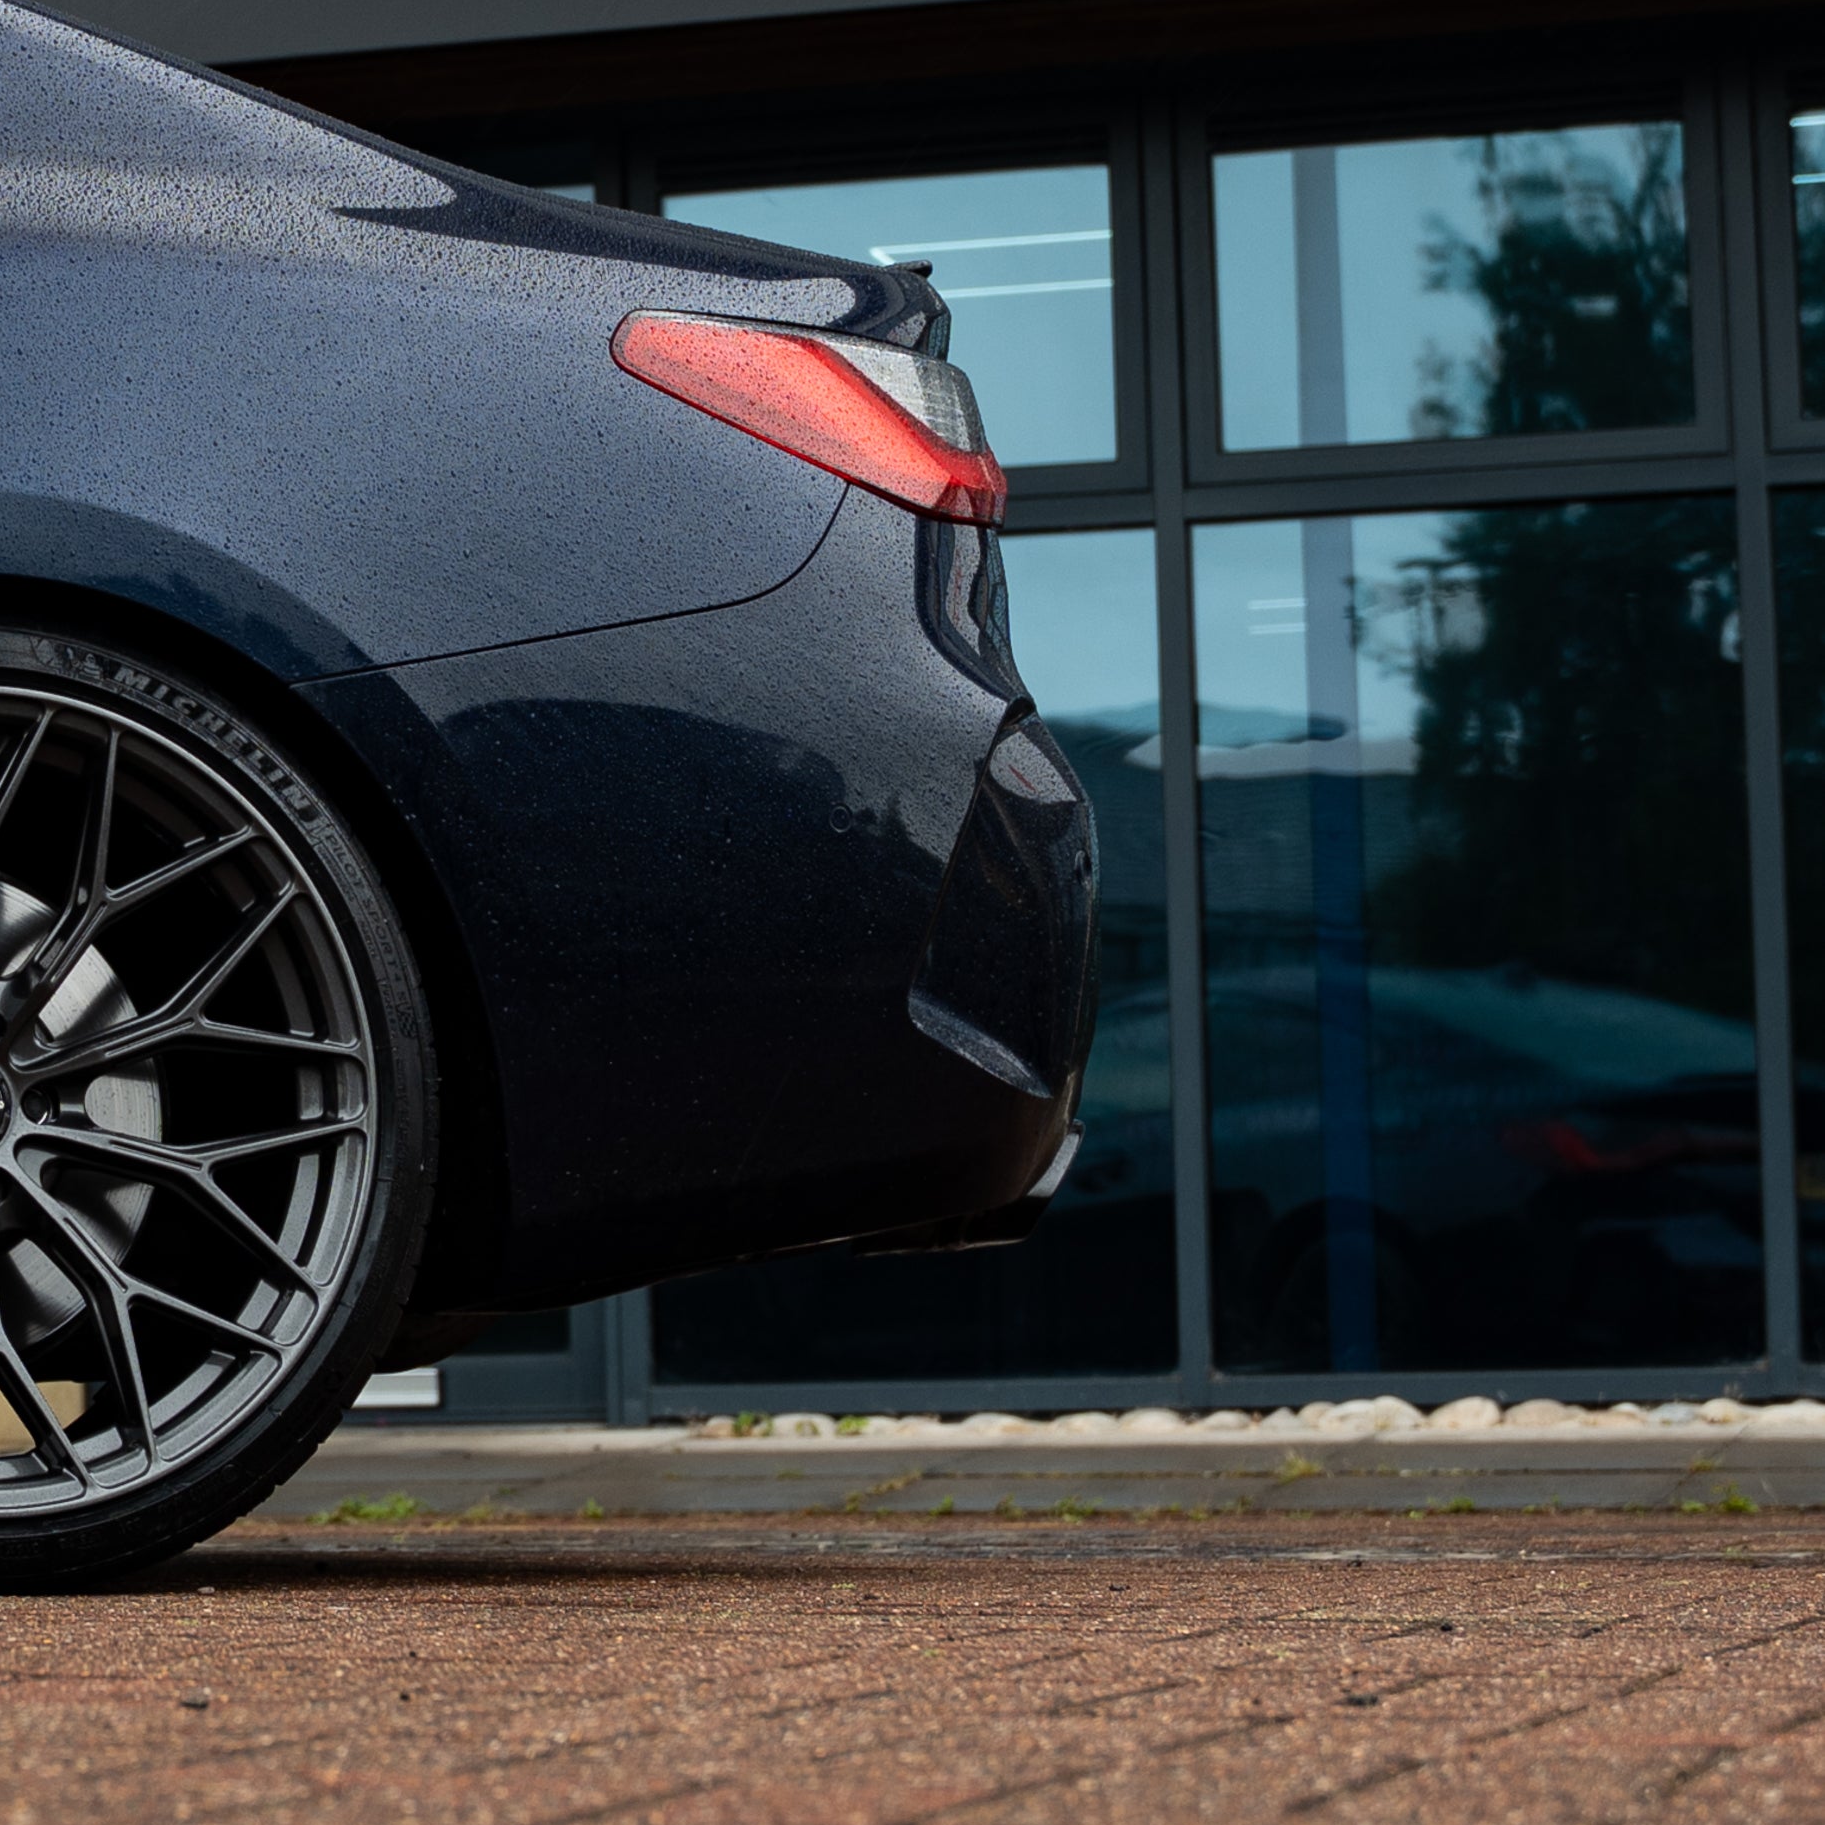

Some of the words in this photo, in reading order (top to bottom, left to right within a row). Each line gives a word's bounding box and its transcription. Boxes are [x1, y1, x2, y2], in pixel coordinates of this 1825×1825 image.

[112, 664, 312, 814] MICHELIN
[322, 830, 366, 892] PILOT
[360, 896, 399, 972] SPORT
